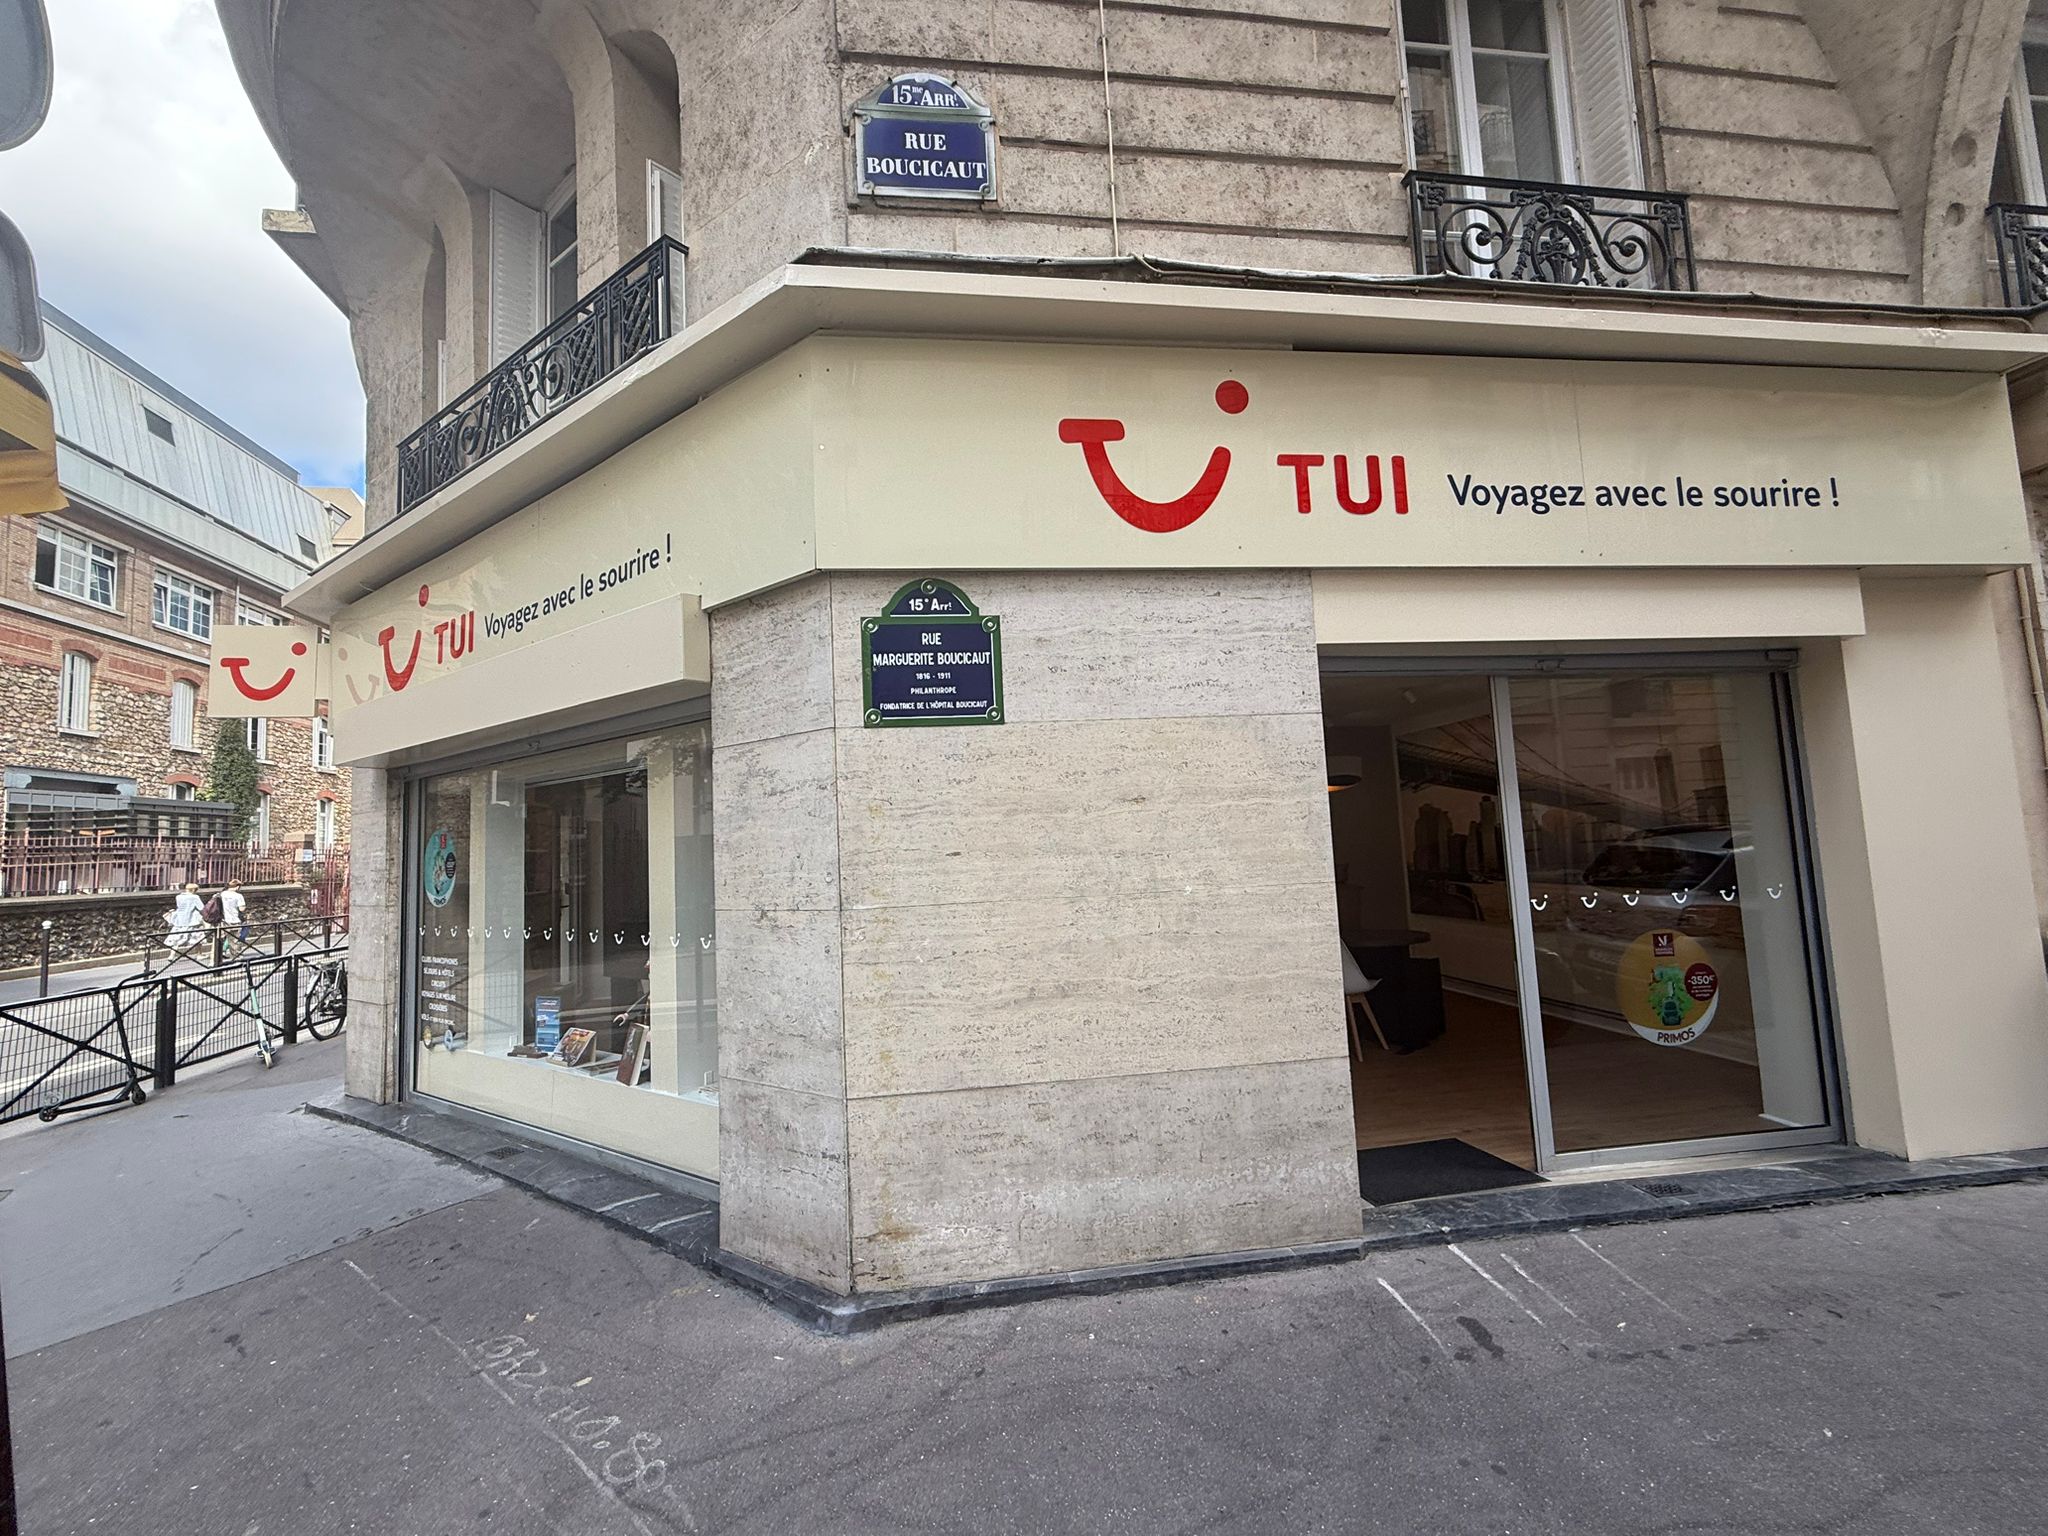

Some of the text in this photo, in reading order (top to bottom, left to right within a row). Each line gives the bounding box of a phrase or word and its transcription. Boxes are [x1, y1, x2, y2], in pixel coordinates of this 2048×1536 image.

[904, 132, 947, 151] RUE
[866, 157, 986, 179] BOUCICAUT
[1277, 454, 1841, 515] TUI Voyagez avec le sourire !
[433, 533, 672, 664] TUI Voyagez avec le sourire !
[921, 632, 942, 645] RUE
[872, 651, 991, 666] MARGUERITE BOUCICAUT
[937, 672, 951, 680] 1911
[910, 686, 957, 695] PHILANTHROPE
[880, 702, 916, 710] FONDATRICE
[916, 701, 925, 709] DE
[955, 700, 988, 708] BOUCICAUT
[1657, 1028, 1696, 1043] PRIMOS
